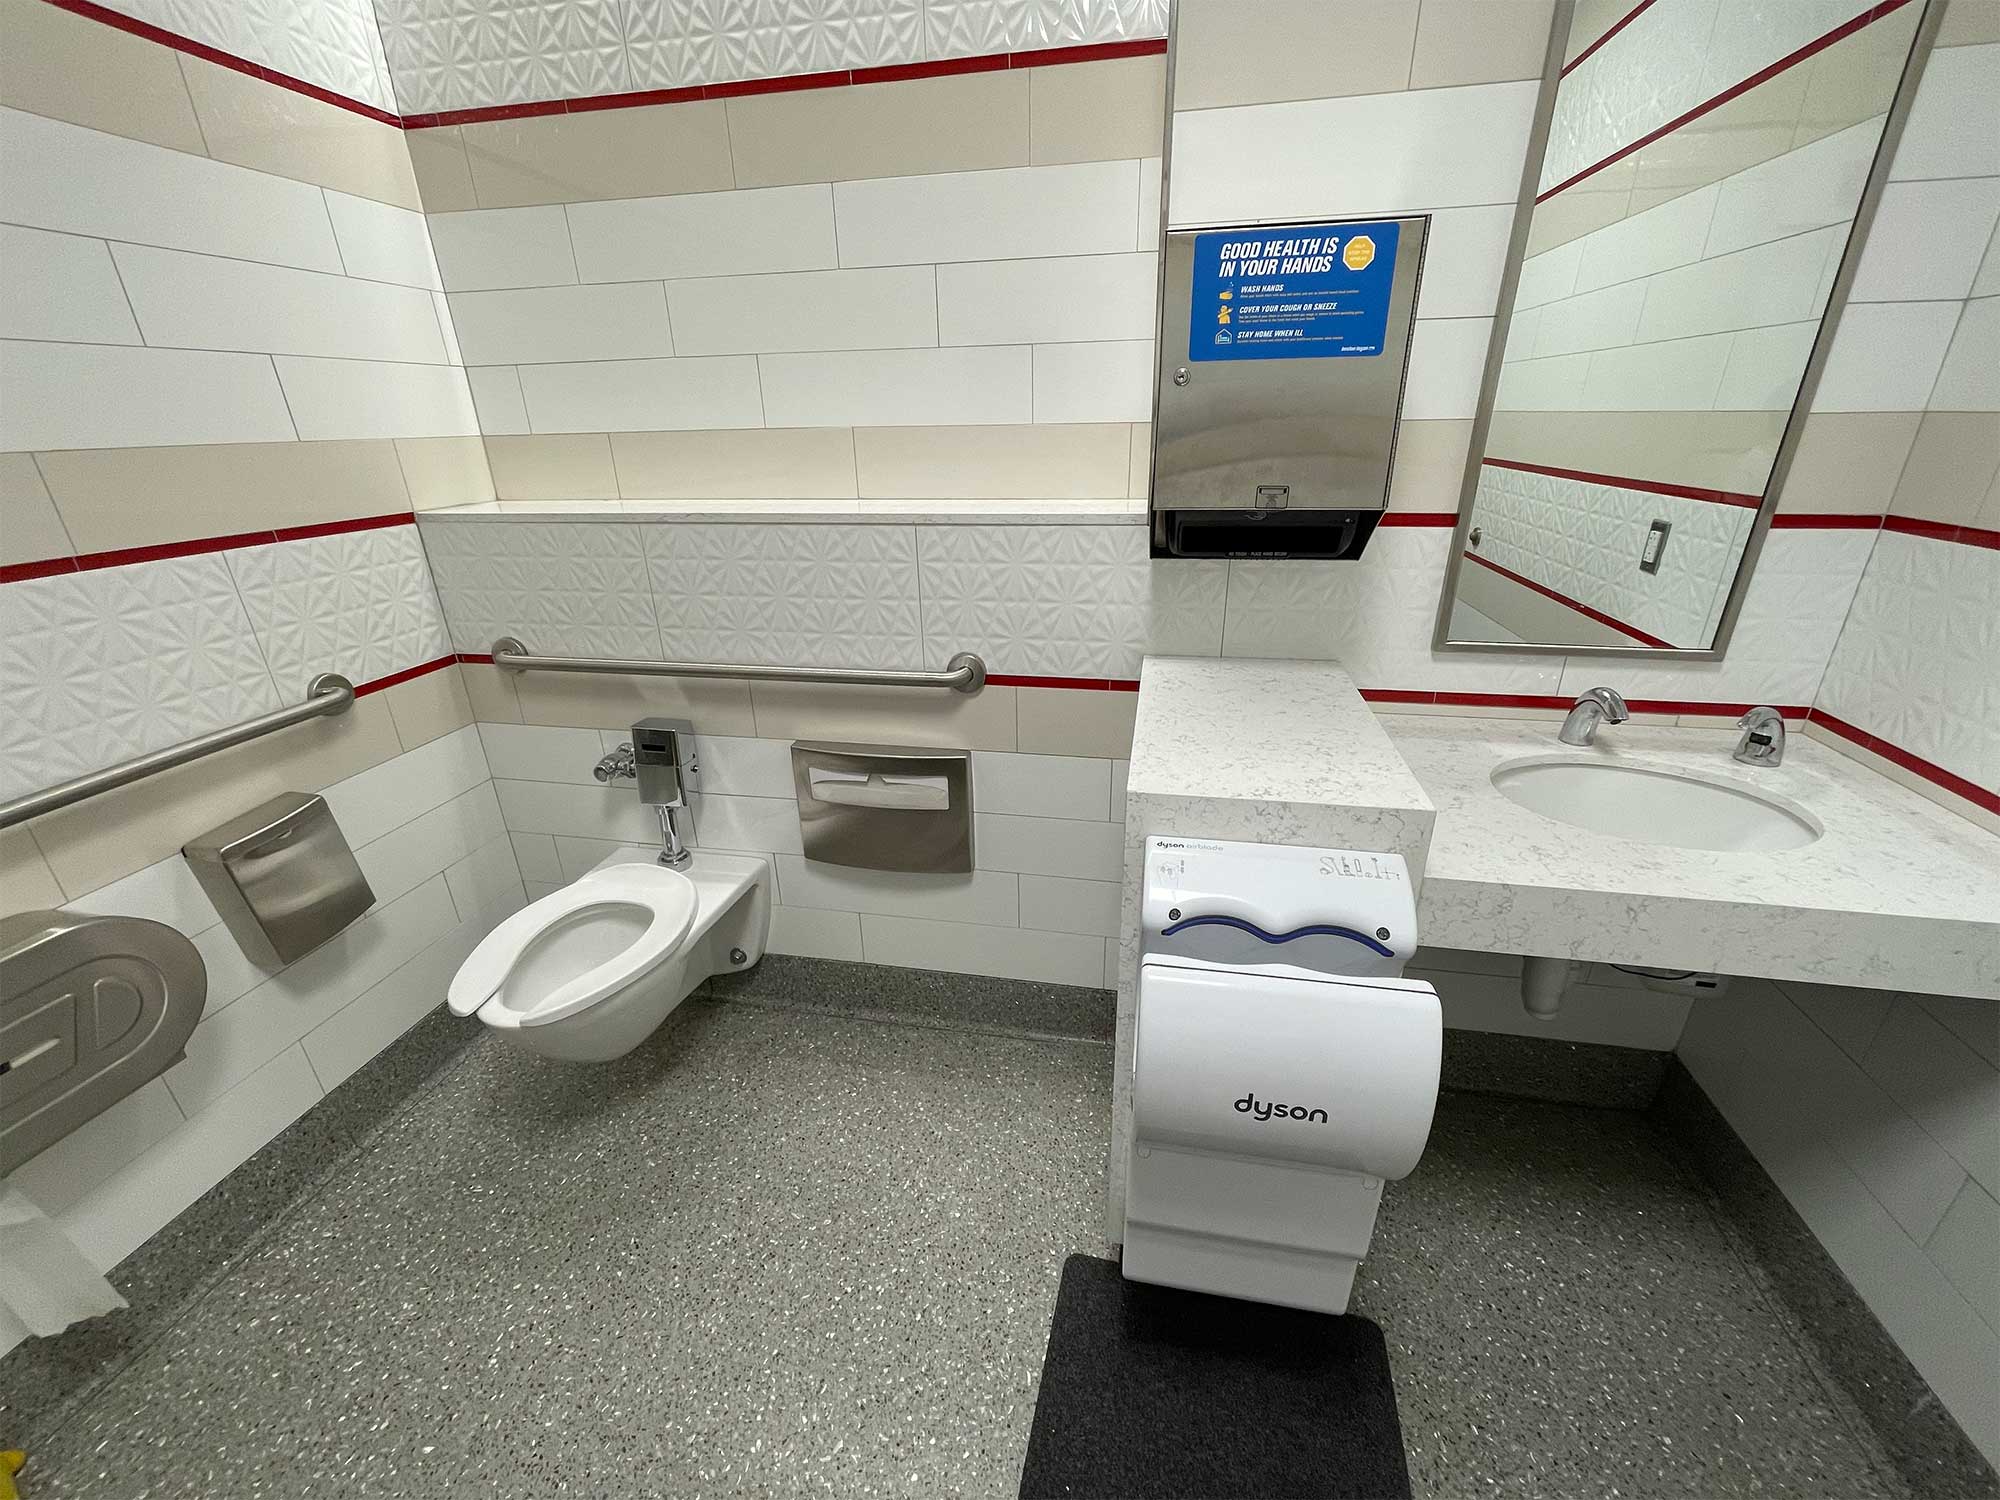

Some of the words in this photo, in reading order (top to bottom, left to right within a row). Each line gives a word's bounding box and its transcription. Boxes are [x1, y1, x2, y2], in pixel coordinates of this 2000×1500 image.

[1220, 242, 1262, 260] GOOD
[1263, 238, 1321, 257] HEALTH
[1322, 237, 1339, 254] IS
[1219, 261, 1236, 277] IN
[1240, 259, 1278, 276] YOUR
[1281, 257, 1333, 274] HANDS
[1240, 285, 1261, 293] WASH
[1261, 284, 1284, 292] HANDS
[1239, 305, 1261, 313] COVER
[1261, 304, 1279, 312] YOUR
[1279, 303, 1302, 312] COUGH
[1303, 303, 1313, 311] OR
[1313, 302, 1338, 310] SNEEZE
[1237, 331, 1254, 339] STAY
[1254, 330, 1273, 338] HOME
[1274, 329, 1294, 337] WHEN
[1294, 329, 1304, 337] ILL
[1156, 841, 1185, 849] dyson
[1233, 1092, 1329, 1124] dyson
